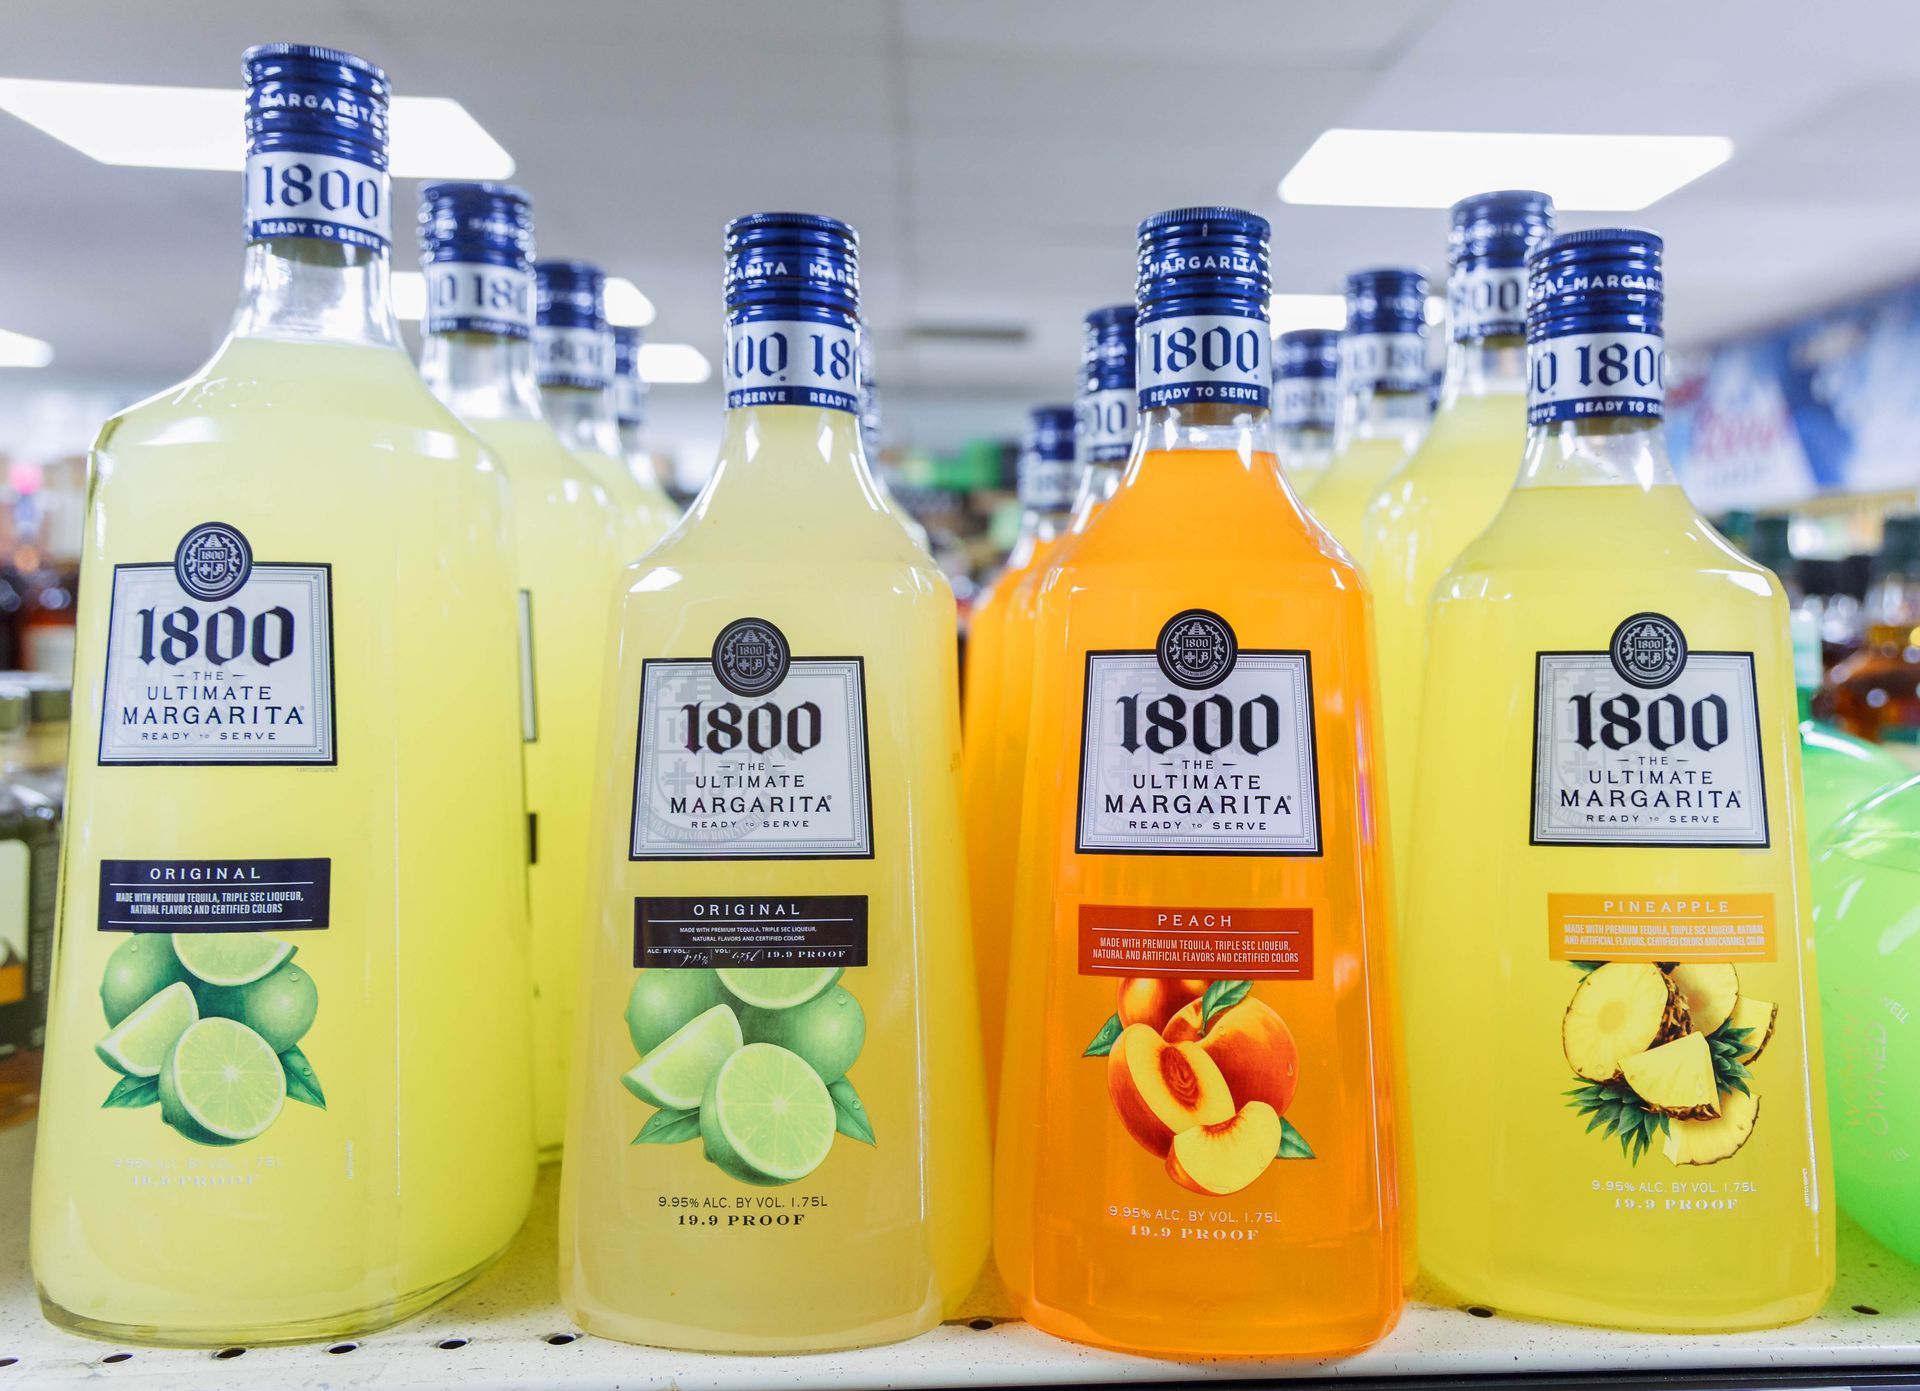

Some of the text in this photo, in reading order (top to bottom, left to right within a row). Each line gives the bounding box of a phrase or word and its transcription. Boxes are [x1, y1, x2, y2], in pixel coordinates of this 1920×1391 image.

[260, 164, 379, 219] 1800
[260, 221, 381, 248] READY TO SERVE
[1150, 255, 1260, 275] MARGARITA
[1150, 326, 1259, 374] 1800
[742, 391, 786, 404] SERVE
[809, 391, 849, 407] READY
[1150, 386, 1259, 402] READY TO SERVE
[1574, 402, 1624, 413] READY
[1627, 401, 1645, 412] TO
[136, 605, 295, 667] 1800
[193, 671, 224, 681] THE
[147, 686, 272, 700] ULTIMATE
[122, 706, 304, 725] MARGARITA
[1569, 692, 1728, 752] 1800
[681, 701, 822, 755] 1800
[1115, 693, 1280, 756] 1800
[142, 732, 190, 741] READY
[220, 732, 276, 740] SERVE
[738, 762, 765, 771] THE
[1182, 760, 1214, 770] THE
[1638, 756, 1669, 765] THE
[695, 775, 805, 788] ULTIMATE
[1133, 774, 1262, 789] ULTIMATE
[1589, 770, 1713, 785] ULTIMATE
[670, 796, 831, 813] MARGARITA
[1104, 794, 1292, 815] MARGARITA
[1560, 789, 1742, 808] MARGARITA
[763, 820, 809, 828] SERVE
[1129, 820, 1182, 829] READY
[1212, 821, 1267, 830] SERVE
[1586, 814, 1639, 822] READY
[1669, 815, 1720, 823] SERVE
[150, 867, 261, 880] ORIGINAL
[115, 891, 304, 904] MADE WITH PREMIUM TEQUILA, TRIPLE SEC LIQUEUR,
[130, 904, 283, 915] NATURAL FLAVORS AND CERTIFIED COLORS
[693, 904, 800, 916] ORIGINAL
[1604, 901, 1729, 913] PINEAPPLE
[1158, 914, 1232, 927] PEACH
[679, 926, 695, 934] MADE
[695, 926, 710, 934] WITH
[711, 926, 736, 934] PREMIUM
[1100, 937, 1291, 952] MADE WITH PREMIUM TEQUILA, TRIPLE SEC LIQUEUR,
[798, 950, 846, 958] PROOF
[1092, 949, 1299, 963] NATURAL AND ARTIFICIAL FLAVORS AND CERTIFIED COLORS
[1591, 1180, 1757, 1194] 9.95% ALC. BY VOL. 1.75L
[658, 1196, 828, 1209] 9.95% ALC. BY VOL. 1.75L
[1665, 1198, 1738, 1210] PROOF
[678, 1214, 805, 1226] 19.9 PROOF
[1109, 1205, 1281, 1223] 9.95% ALC. BY VOL. 1.75L
[1130, 1225, 1259, 1241] 19.9 PROOF
